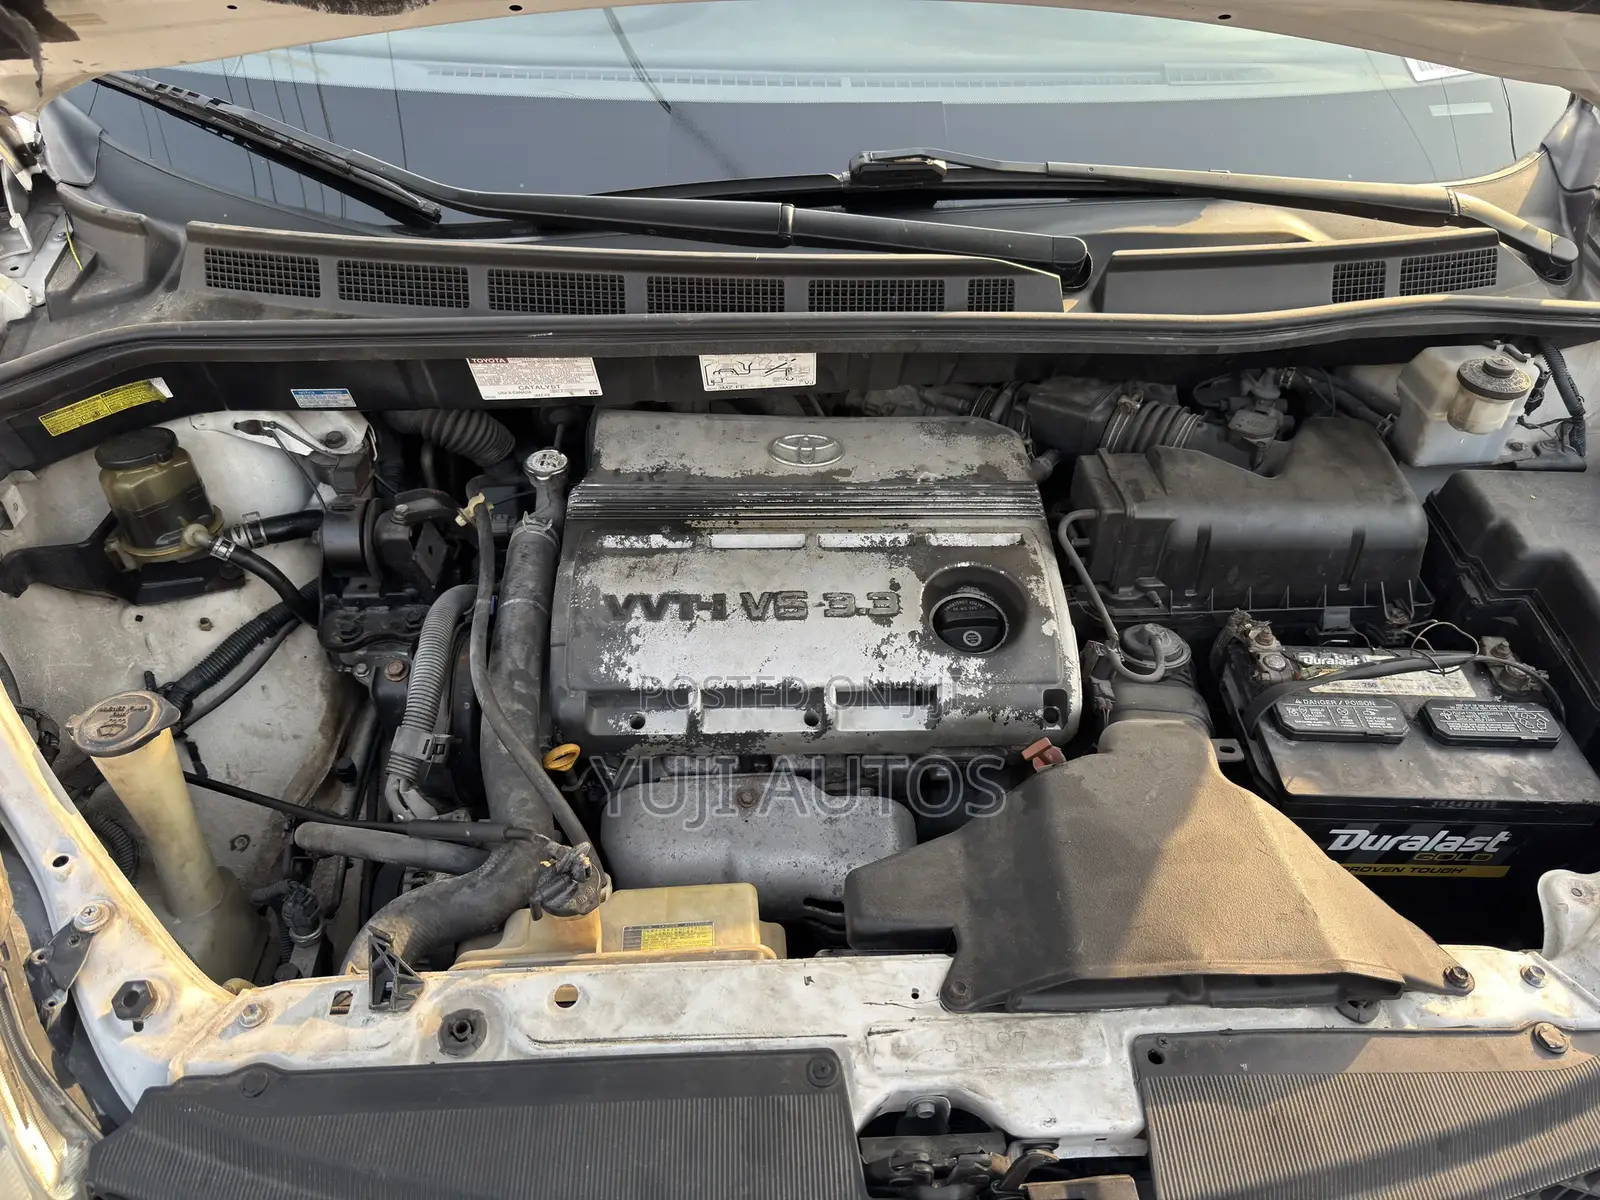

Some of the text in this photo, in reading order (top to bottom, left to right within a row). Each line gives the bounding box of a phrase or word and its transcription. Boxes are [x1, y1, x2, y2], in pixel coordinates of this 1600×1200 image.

[739, 591, 808, 620] V6
[822, 592, 900, 618] 3.3
[1299, 655, 1360, 665] Duralast
[1327, 829, 1512, 852] Duralast
[1412, 853, 1494, 862] GOLD
